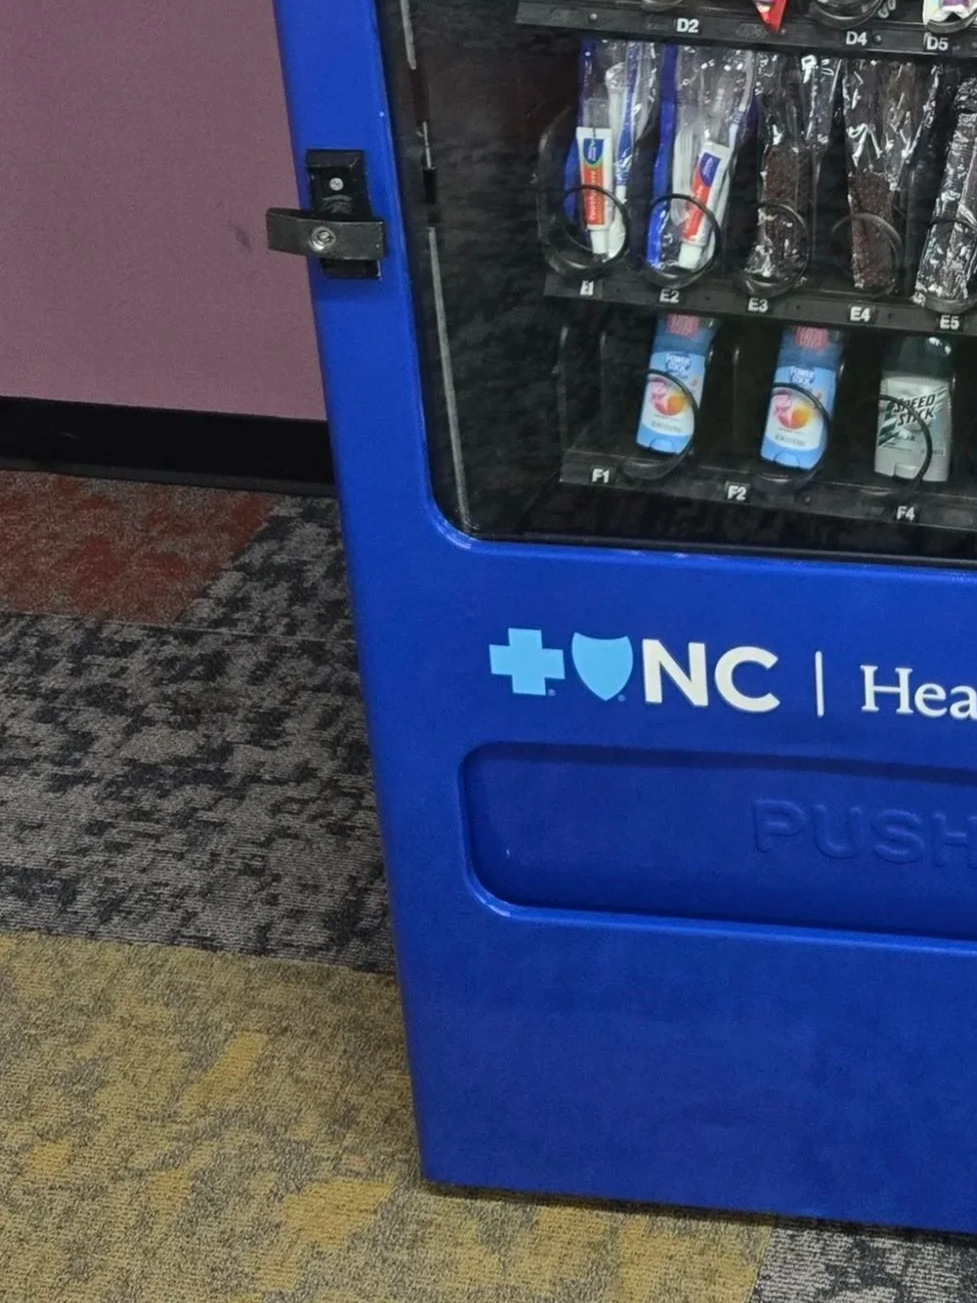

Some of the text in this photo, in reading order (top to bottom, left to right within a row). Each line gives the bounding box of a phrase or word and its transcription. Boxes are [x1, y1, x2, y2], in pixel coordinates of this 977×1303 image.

[676, 19, 700, 33] D2
[845, 31, 867, 46] D4
[927, 37, 948, 51] D5
[659, 289, 680, 304] E2
[747, 298, 768, 313] E3
[850, 307, 870, 322] E4
[940, 316, 960, 330] E5
[592, 469, 609, 484] F1
[727, 486, 748, 501] F2
[896, 506, 916, 521] F4
[642, 638, 782, 714] NC
